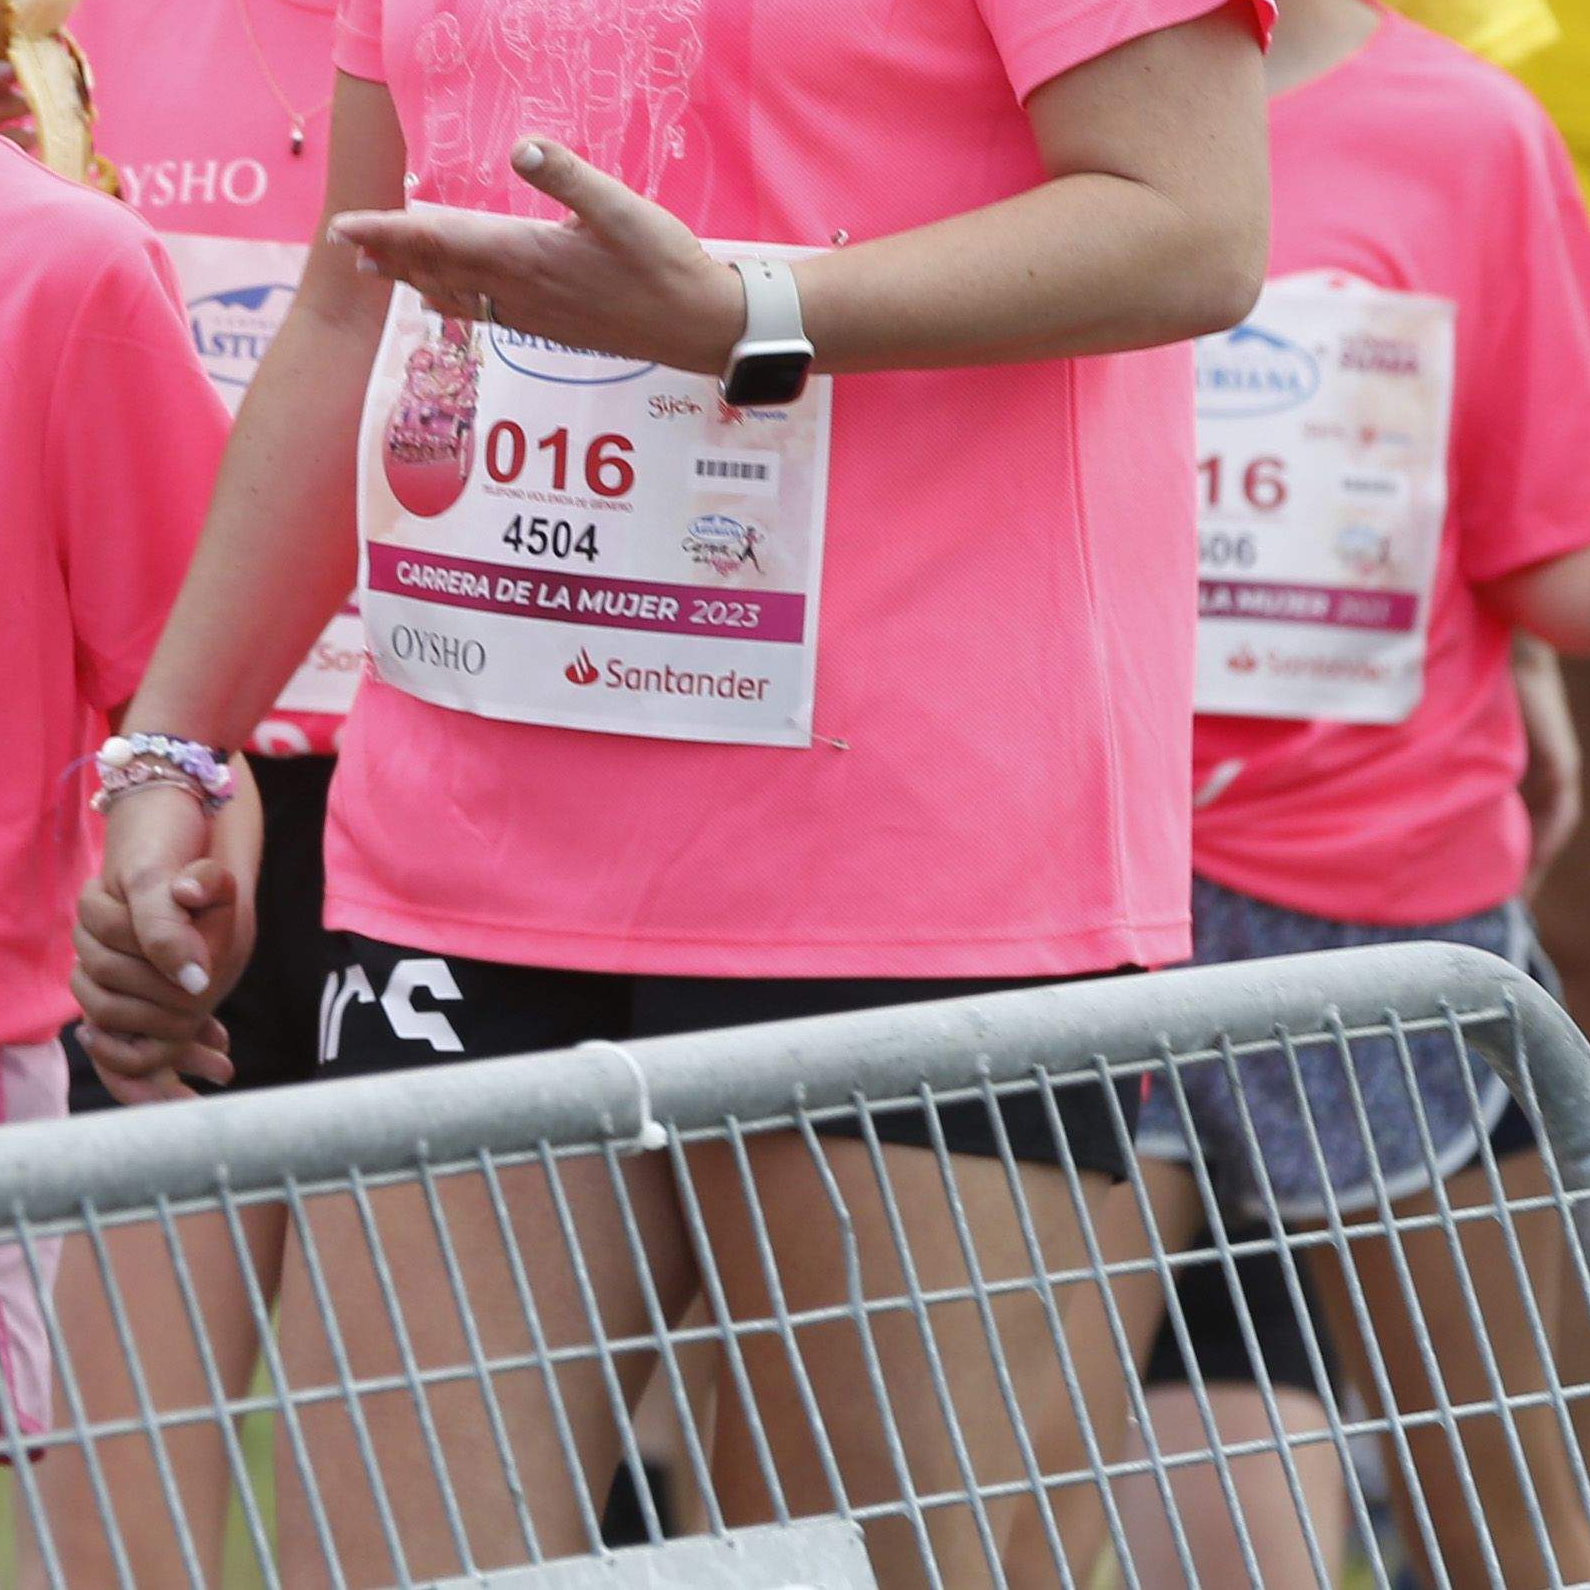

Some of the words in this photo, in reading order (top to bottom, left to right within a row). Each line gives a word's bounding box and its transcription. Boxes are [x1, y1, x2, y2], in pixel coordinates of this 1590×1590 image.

[120, 157, 269, 208] YSHO
[485, 418, 636, 498] 016
[1198, 453, 1288, 513] 16
[502, 513, 600, 563] 4504
[395, 560, 491, 600] CARRERA
[494, 579, 534, 607] DE
[535, 586, 573, 613] LA
[577, 590, 680, 624] MUJER
[688, 599, 763, 629] 2023
[391, 623, 487, 677] OYSHO
[604, 658, 771, 701] Santander
